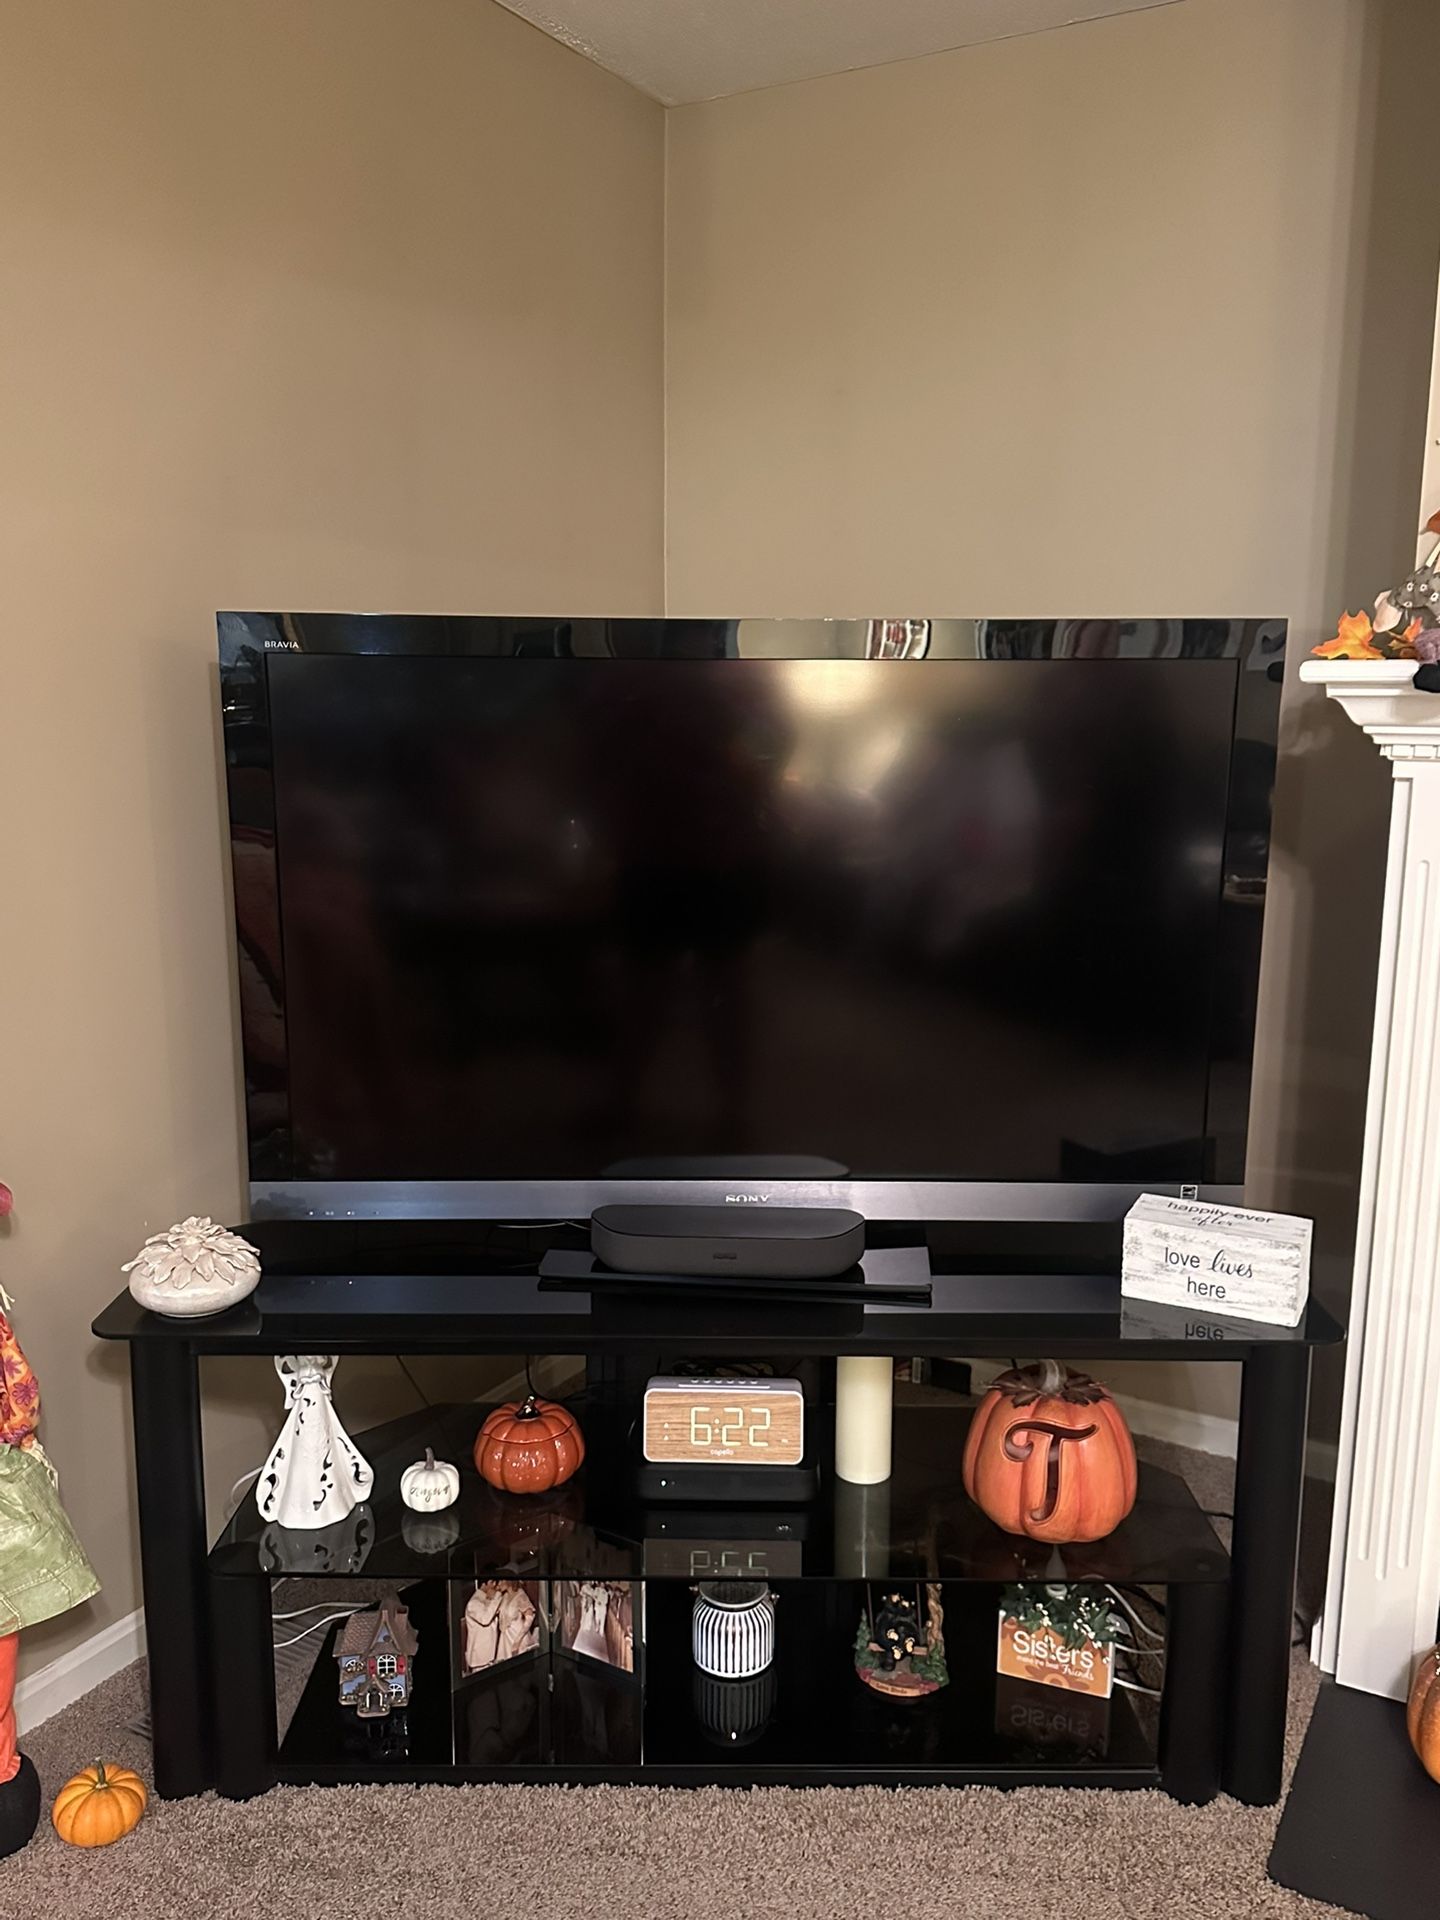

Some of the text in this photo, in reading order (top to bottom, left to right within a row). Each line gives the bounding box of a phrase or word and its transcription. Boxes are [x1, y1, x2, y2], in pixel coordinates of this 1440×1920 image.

[264, 640, 300, 649] BRAVIA
[725, 1194, 769, 1203] SONY
[1167, 1201, 1276, 1224] happily ever
[1191, 1214, 1235, 1227] after
[1164, 1247, 1253, 1279] love lives
[1187, 1276, 1227, 1299] here
[690, 1406, 771, 1447] 6:22
[1004, 1420, 1098, 1522] T
[1013, 1630, 1094, 1668] Sisters
